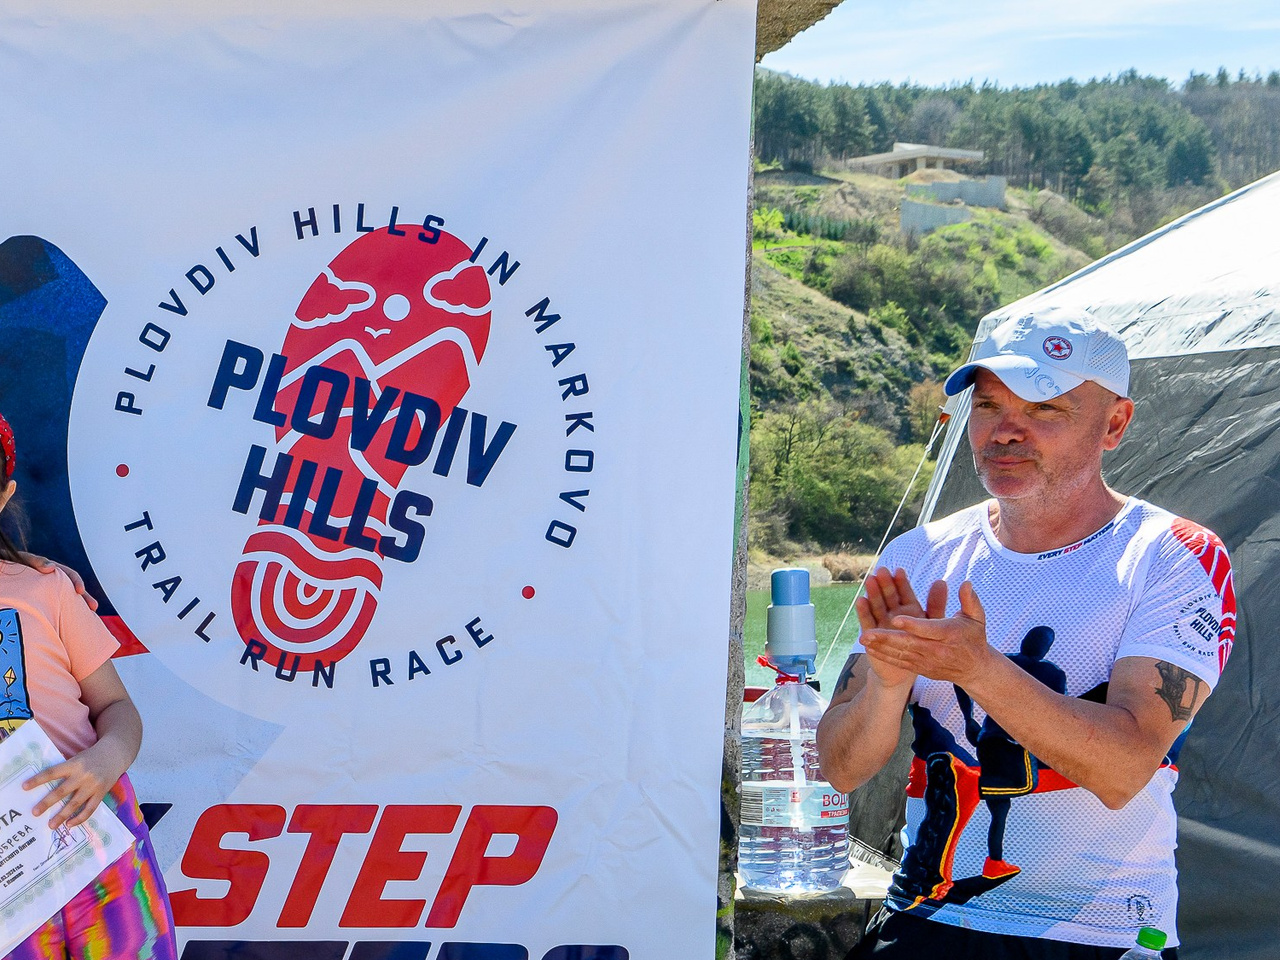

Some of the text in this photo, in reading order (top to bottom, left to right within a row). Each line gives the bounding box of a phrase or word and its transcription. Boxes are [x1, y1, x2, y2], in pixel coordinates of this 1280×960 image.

[114, 203, 596, 549] PLOVDIV HILLS IN MARKOVO
[207, 339, 518, 488] PLOVDIV
[231, 444, 434, 564] HILLS
[1037, 549, 1064, 560] EVERY
[1063, 542, 1083, 554] STEP
[123, 511, 495, 689] TRAIL RUN RACE
[1190, 618, 1214, 642] HILLS
[168, 804, 559, 929] STEP
